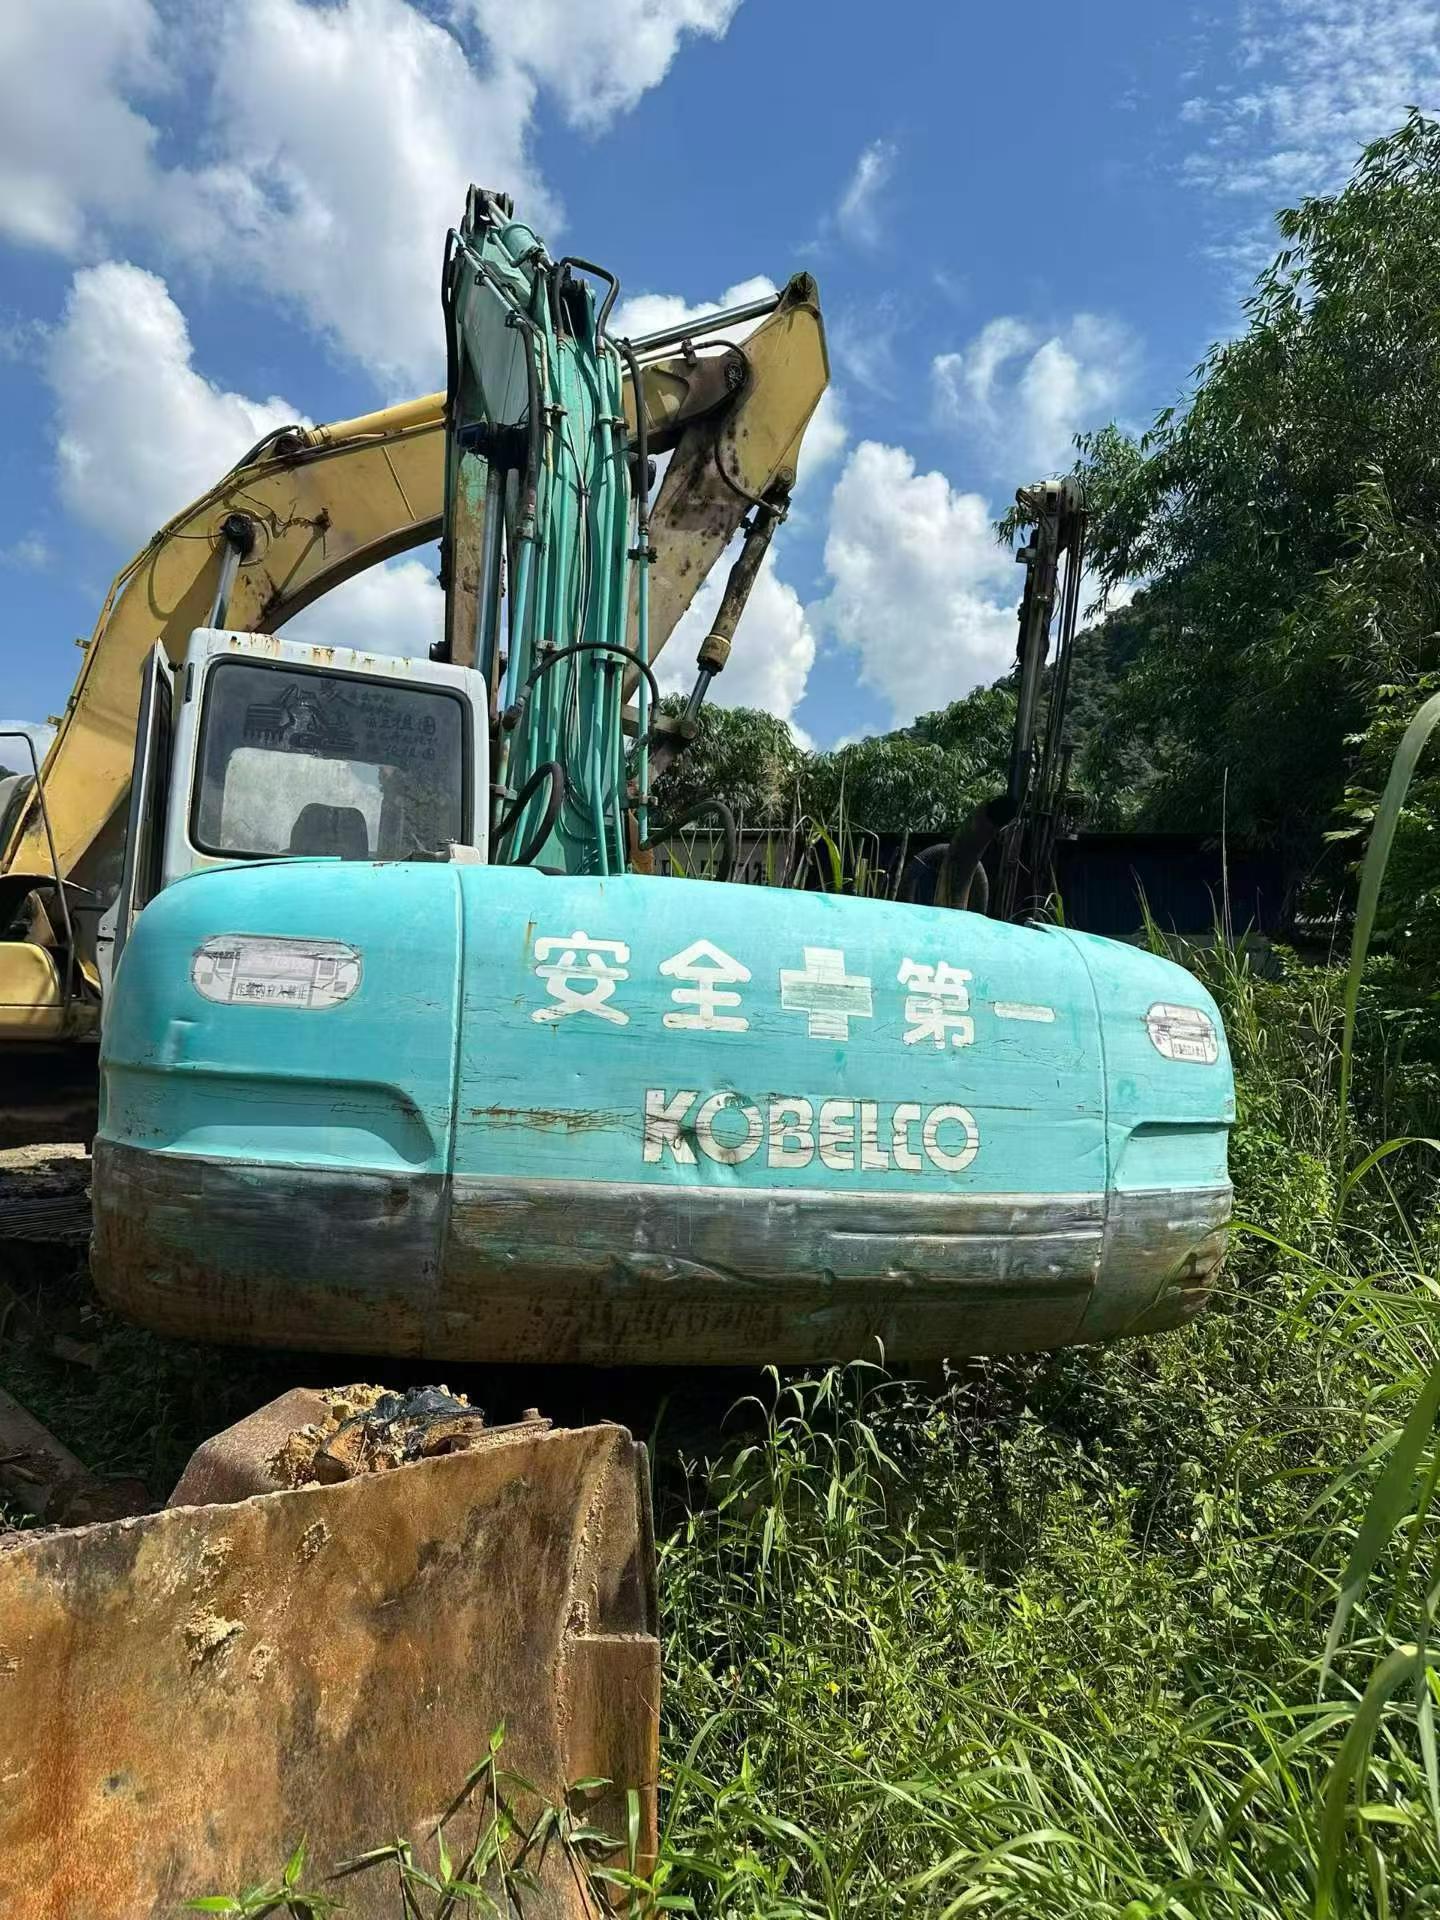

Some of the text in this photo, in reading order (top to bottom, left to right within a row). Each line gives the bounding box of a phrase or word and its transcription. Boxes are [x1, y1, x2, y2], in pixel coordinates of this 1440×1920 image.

[532, 931, 1057, 1049] 安全 第一
[642, 1087, 980, 1172] KOBELCO
